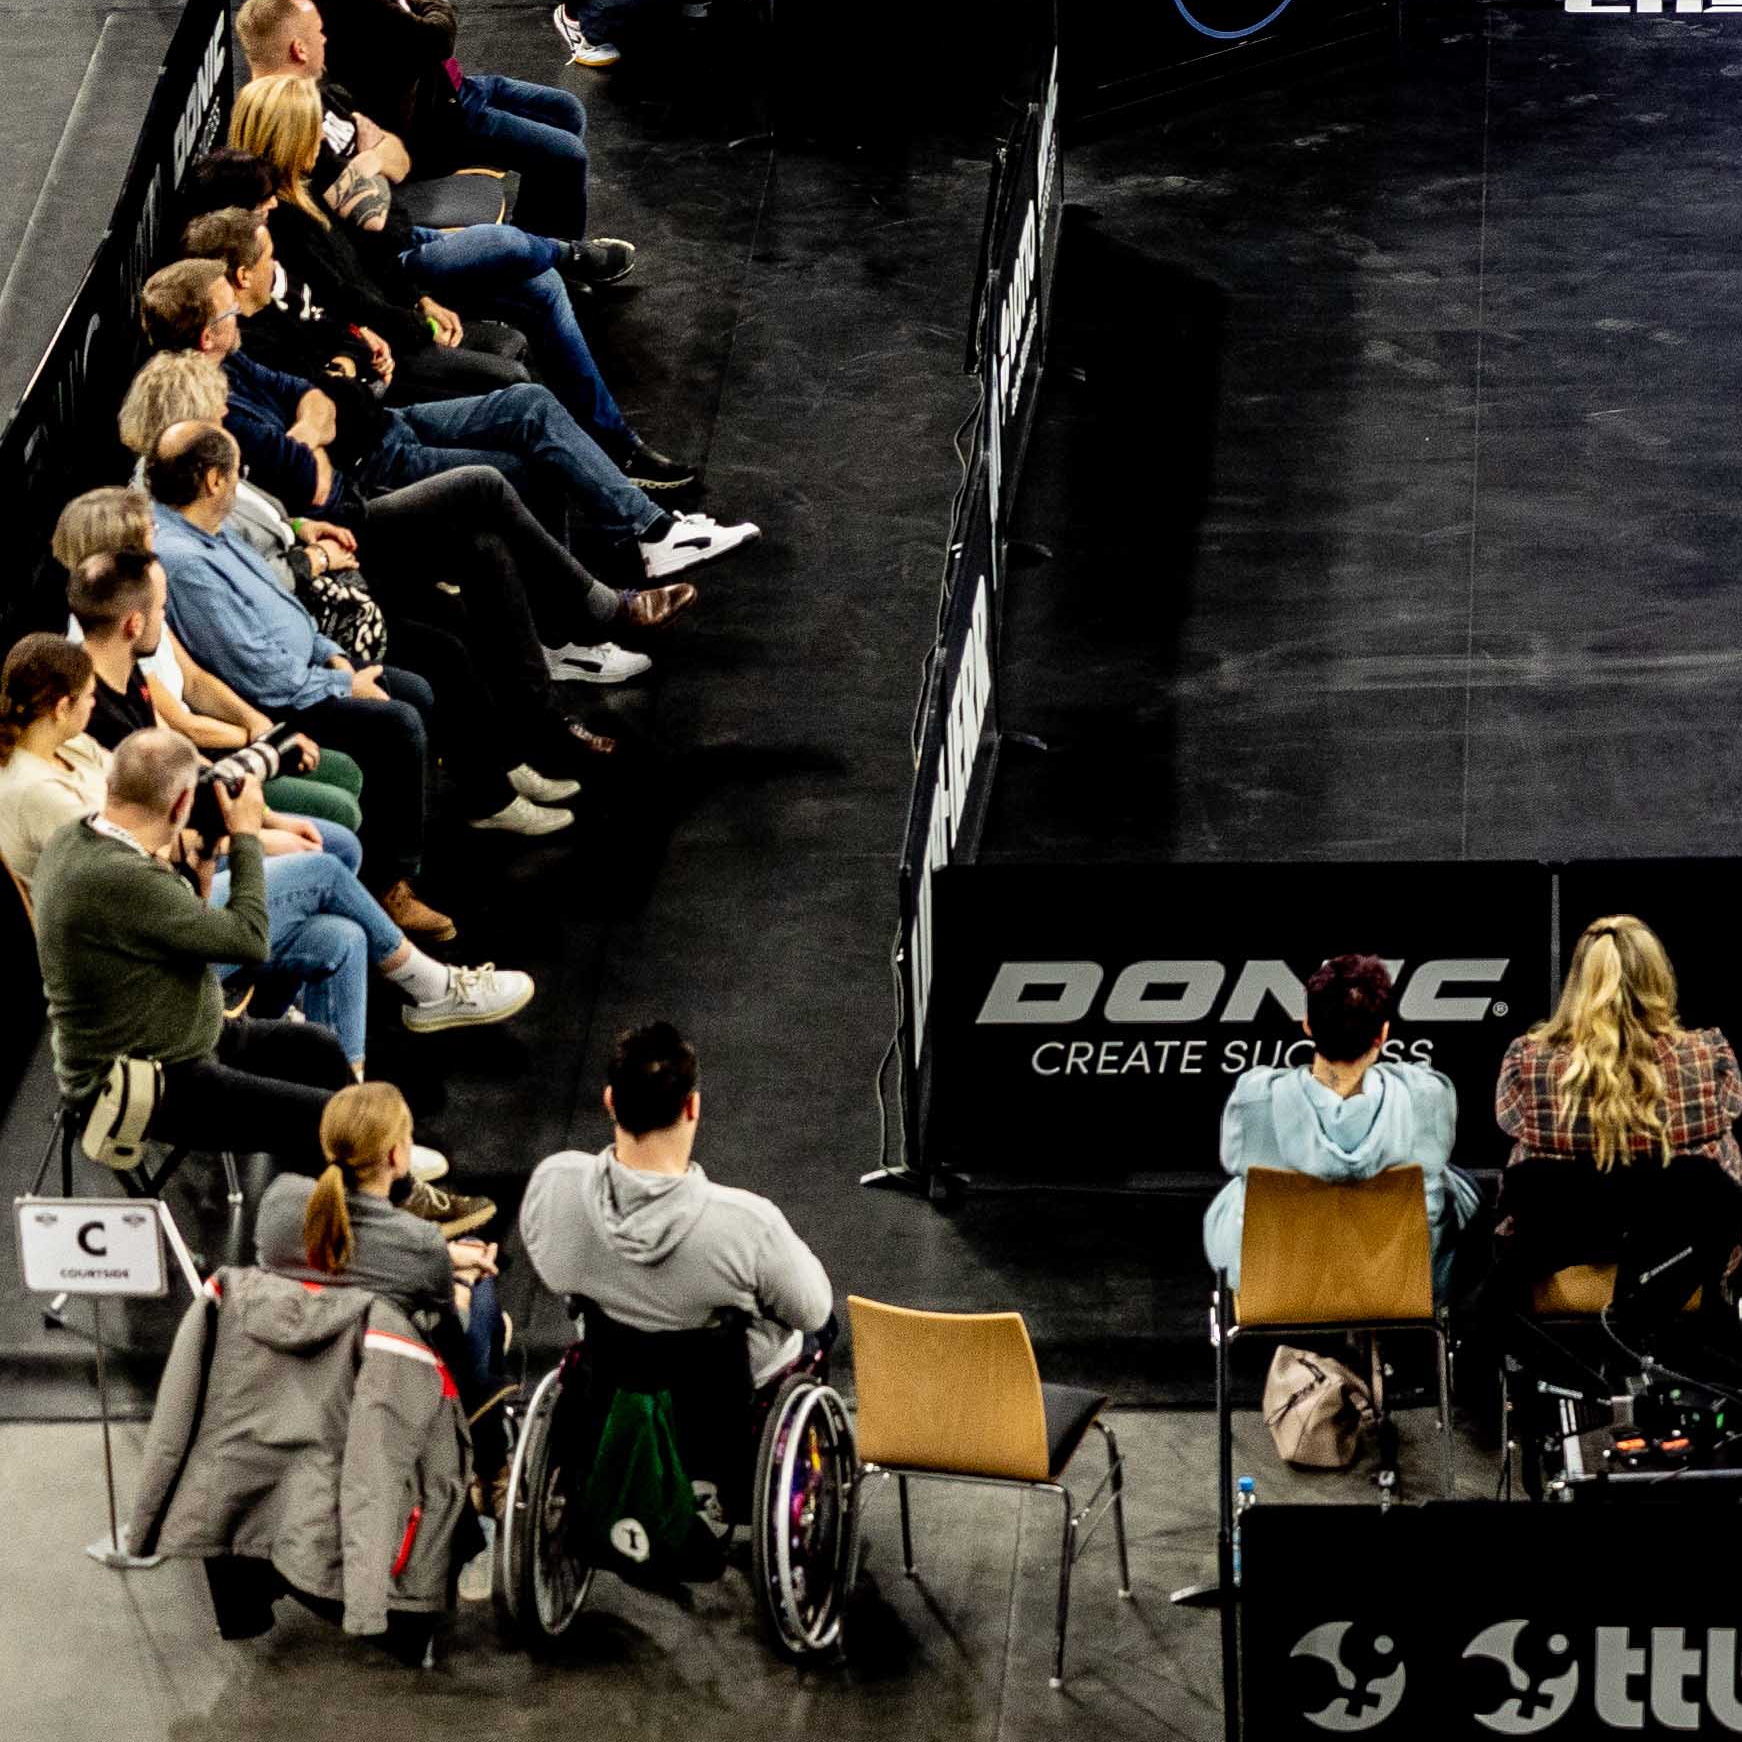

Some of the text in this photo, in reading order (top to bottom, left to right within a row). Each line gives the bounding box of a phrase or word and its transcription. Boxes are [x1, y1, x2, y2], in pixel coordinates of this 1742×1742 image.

[975, 958, 1510, 1025] DONC
[1032, 1039, 1434, 1076] CREATE SUCSS
[76, 1221, 107, 1258] C
[59, 1268, 131, 1281] COURTSIDE
